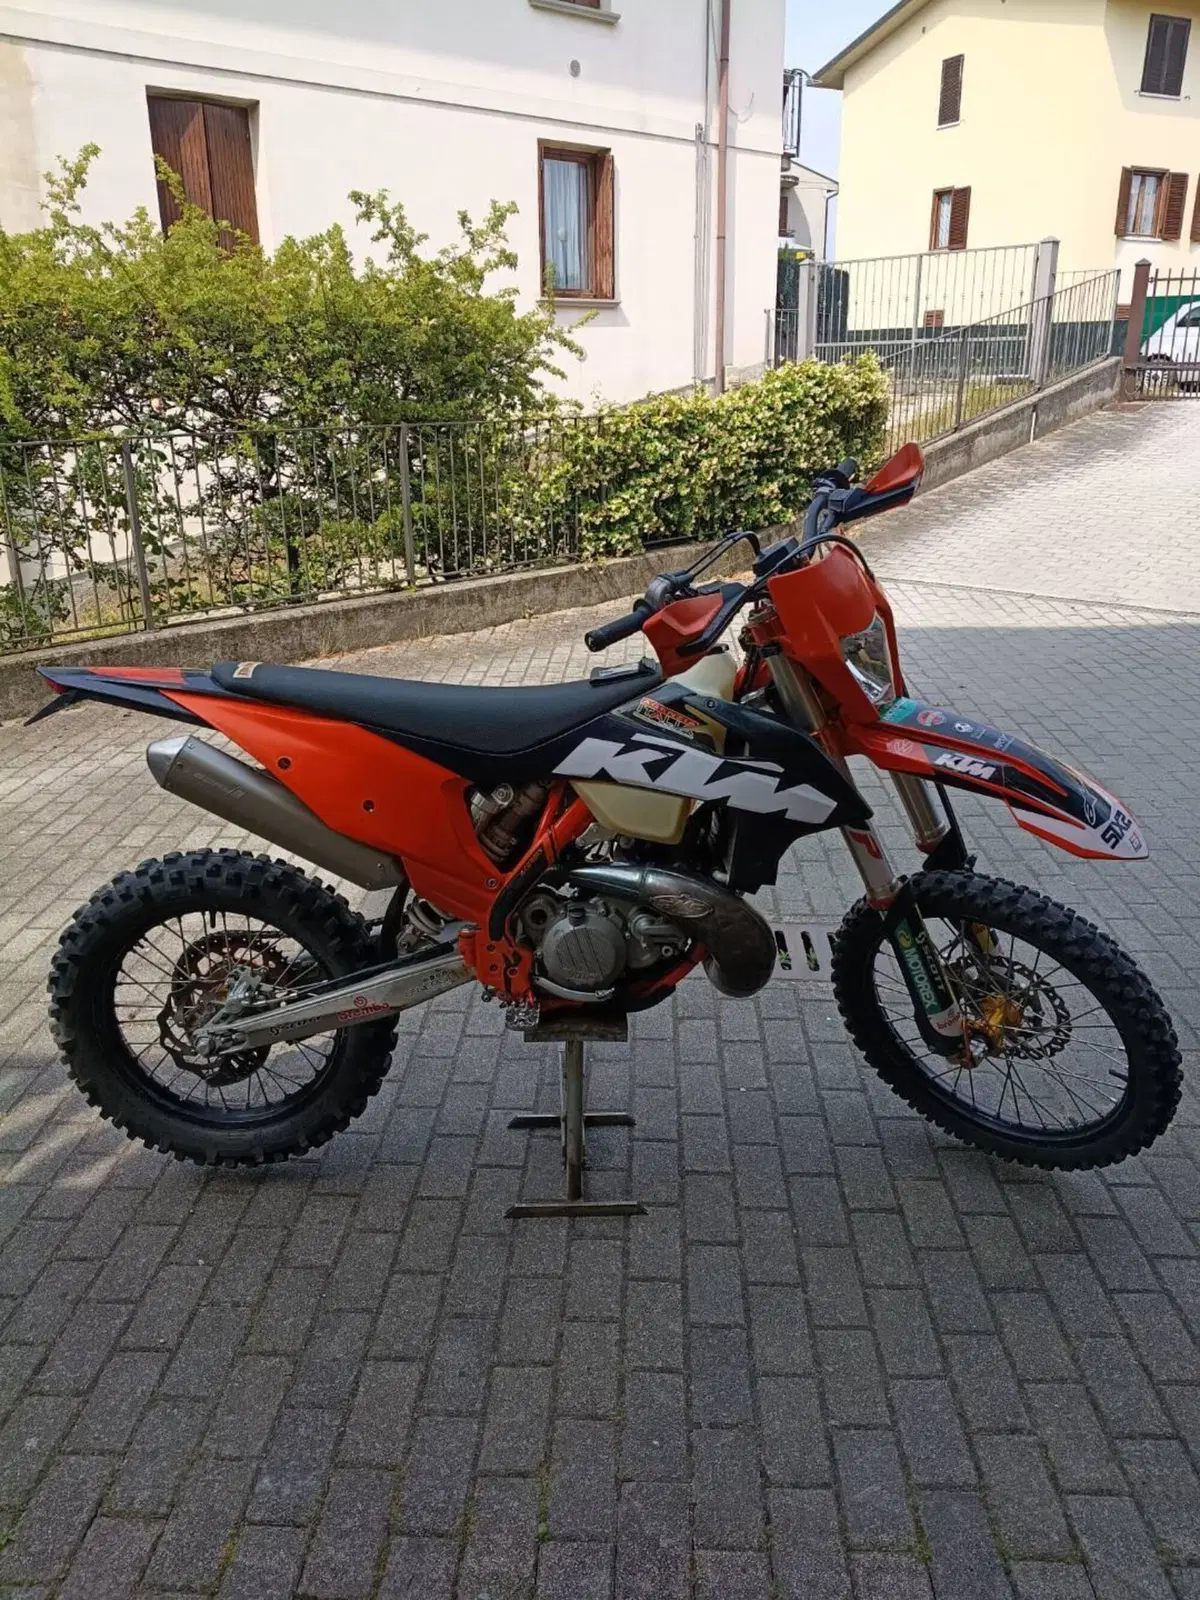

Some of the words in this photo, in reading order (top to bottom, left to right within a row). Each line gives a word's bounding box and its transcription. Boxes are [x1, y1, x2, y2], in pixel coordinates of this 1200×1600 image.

[553, 734, 838, 824] KTM
[934, 752, 996, 780] KTM
[904, 948, 938, 1008] MOTOREX
[338, 1003, 392, 1022] brembo
